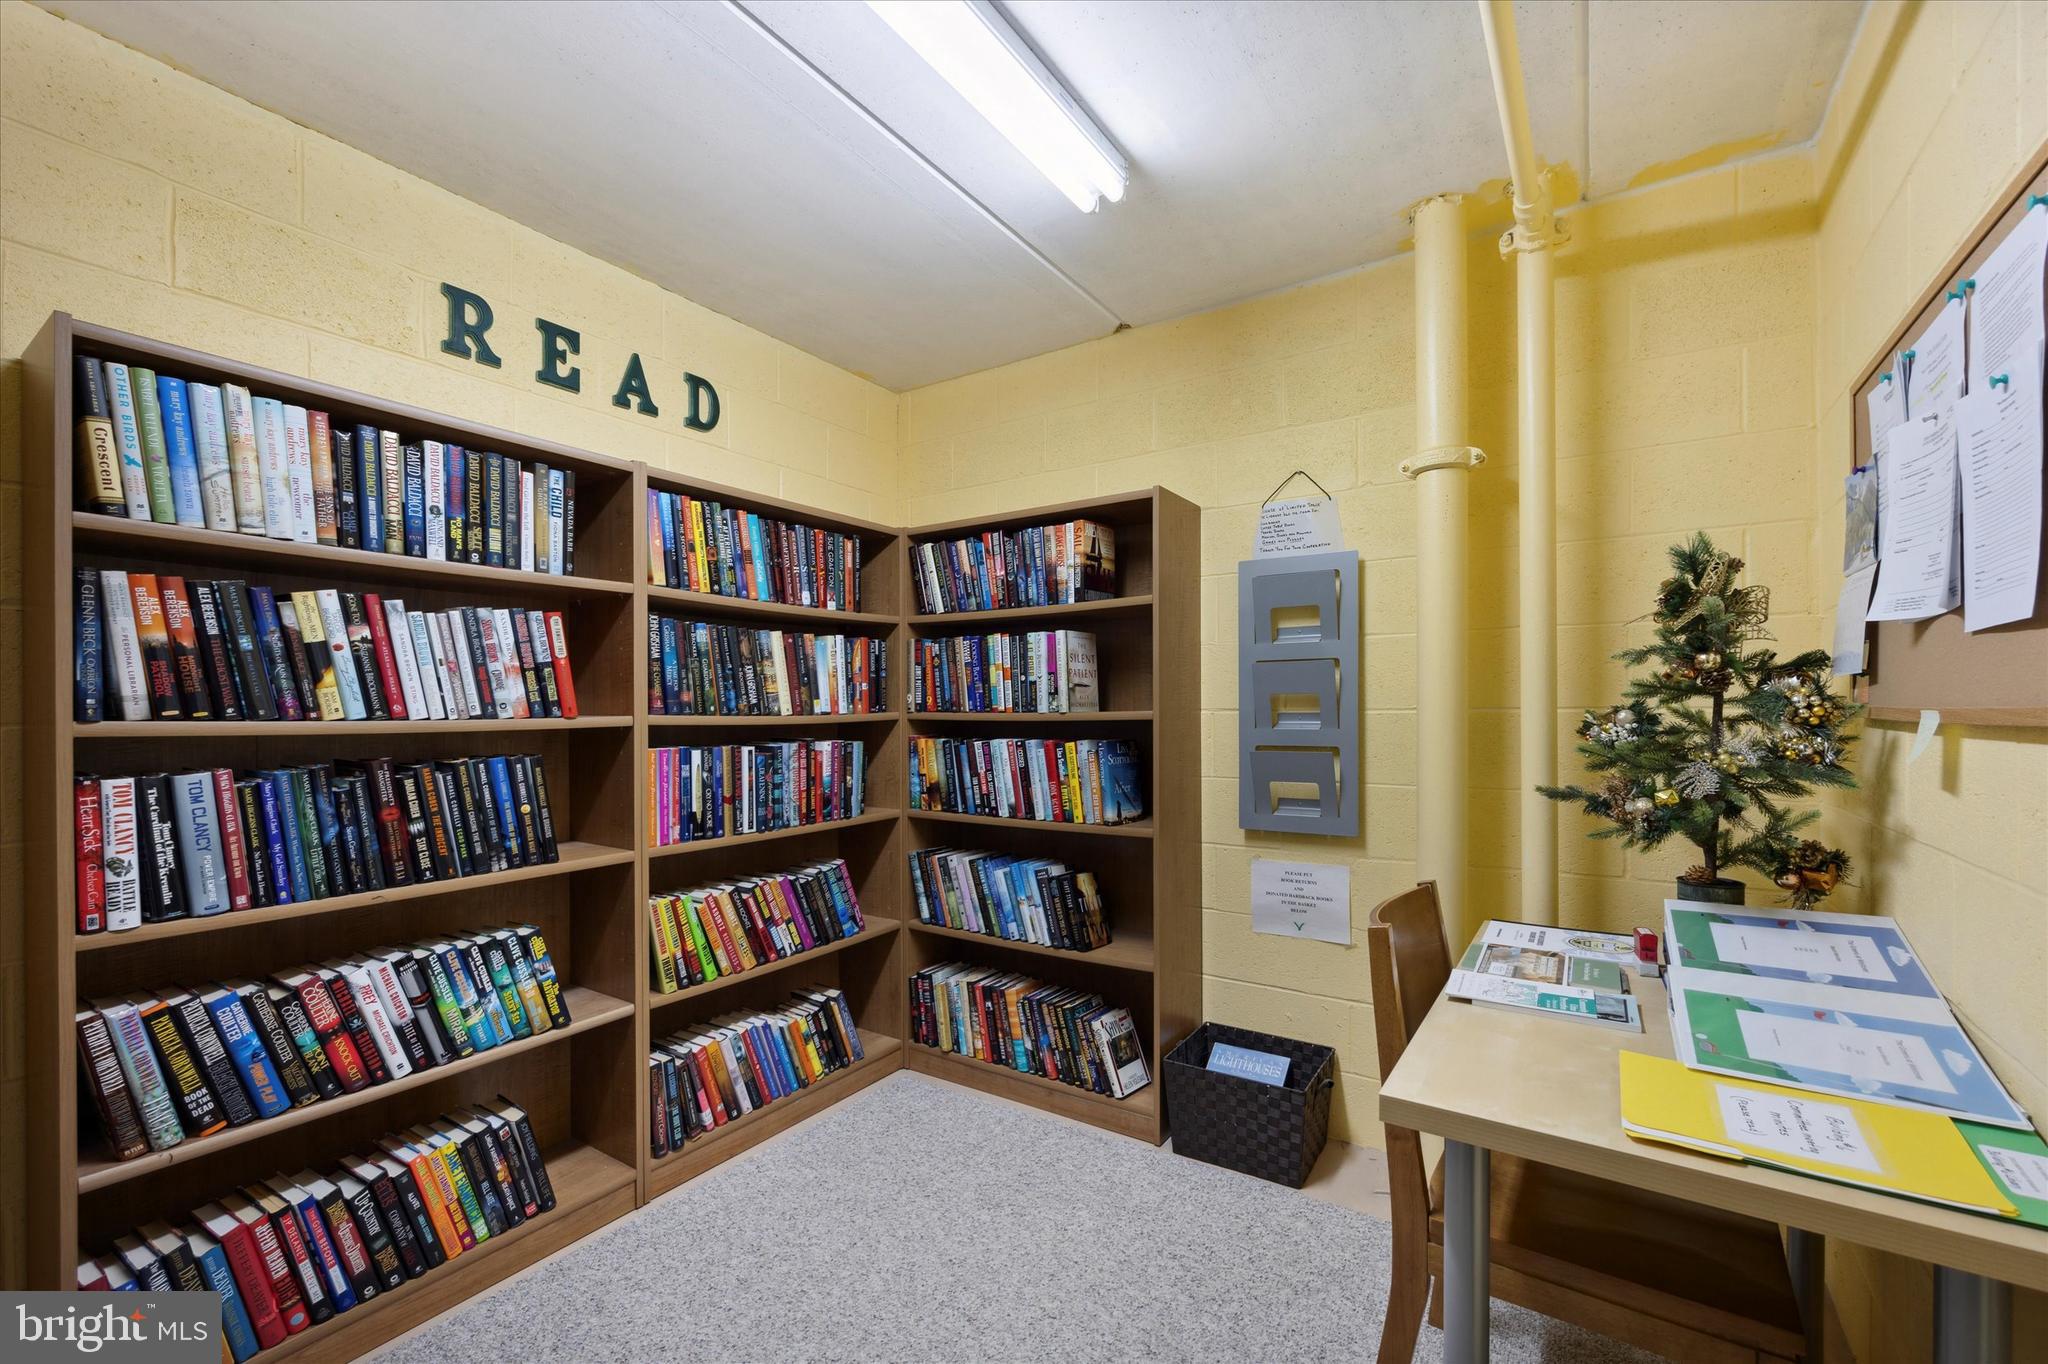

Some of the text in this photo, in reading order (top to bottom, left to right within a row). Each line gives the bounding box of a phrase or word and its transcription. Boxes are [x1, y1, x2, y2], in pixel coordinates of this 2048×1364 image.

[440, 282, 720, 433] READ
[114, 367, 136, 449] OTHER BIRDS
[93, 427, 118, 491] Crescent
[364, 440, 377, 496] DAVID BALDACCI
[384, 436, 401, 515] DAVID BALDACCI
[430, 444, 442, 504] DAVID BALDACCI
[490, 467, 500, 489] DAVID
[407, 451, 422, 517] DAVID BALDACCI
[469, 457, 480, 523] DAVID BALDACCI
[491, 491, 500, 526] BALDACCI
[551, 488, 562, 519] CHILD
[385, 520, 397, 540] MAN
[722, 525, 733, 567] AFTERIMAGE
[1074, 527, 1082, 548] SAIL
[81, 584, 96, 656] GLENN BECK
[134, 587, 152, 625] BERENSON
[149, 597, 161, 615] ALEX
[163, 590, 181, 628] BERENSON
[177, 601, 190, 618] ALEX
[197, 587, 220, 635] ALEX BERENSON
[467, 609, 478, 641] SANDRA
[410, 614, 432, 667] SANDRA BROWN
[480, 619, 494, 641] SANDRA
[648, 614, 661, 659] JOHN GRISHAM
[121, 634, 139, 706] PERSONAL LIBRARIAN
[472, 639, 483, 663] BROWN
[150, 661, 164, 698] PATROL
[178, 656, 194, 694] HOUSE
[744, 665, 758, 704] JOHN GRISHAM
[404, 778, 418, 800] HARLAN
[422, 767, 434, 790] HARLAN
[482, 785, 492, 808] CONNELLY
[112, 783, 134, 855] TOM CLANCY
[188, 780, 211, 852] TOM CLANCY
[262, 783, 279, 835] Mary Higgins Clark
[446, 775, 461, 827] MICHAEL CONNELLY
[147, 787, 173, 905] The Cardinal of the Kremlin
[161, 821, 176, 869] Tom Clancy
[416, 837, 431, 869] STAY CLOSE
[431, 815, 448, 856] THE INNOCENT
[272, 843, 287, 887] My Gal Sunday
[86, 864, 100, 910] Chelsea Cain
[106, 881, 122, 913] READY
[122, 878, 137, 913] BATTLE
[427, 954, 454, 1004] CLIVE CUSSLER
[506, 937, 532, 992] CLIVE CUSSLER
[662, 956, 675, 984] THERAPY
[301, 987, 329, 1030] COULTER
[314, 981, 338, 1024] CATHERINE
[359, 984, 377, 1006] PREY
[378, 966, 408, 1021] MICHAEL CRICHTON
[542, 979, 560, 1016] NAVIGATOR
[118, 1012, 143, 1053] PATRICIA
[180, 998, 227, 1066] PATRICIA CORNWELL
[215, 1007, 241, 1043] COULTER
[230, 1001, 254, 1036] CATHERINE
[252, 992, 293, 1063] CATHERINE COULTER
[281, 1006, 304, 1040] COULTER
[290, 1000, 312, 1032] CATHERINE
[372, 1009, 398, 1056] MICHAEL CRICHTON
[446, 1007, 468, 1045] MIRAGE
[82, 1018, 113, 1056] PATRICIA
[150, 1014, 202, 1094] PATRICIA CORNWELL
[401, 1022, 414, 1039] STATE
[412, 1043, 425, 1059] FEAR
[93, 1053, 126, 1096] CORNWELL
[303, 1050, 320, 1075] BLANK
[312, 1046, 330, 1069] POINT
[334, 1037, 361, 1081] KNOCK OUT
[1214, 1053, 1281, 1078] LIGHTHOUSES
[143, 1092, 177, 1135] TRACE
[183, 1087, 207, 1102] BOOK
[191, 1101, 215, 1117] DEAD
[430, 1156, 444, 1173] JANET
[443, 1151, 479, 1220] JANET EVANOVICH
[358, 1203, 382, 1236] COUNTRY
[282, 1217, 306, 1262] JP DELANEY
[310, 1220, 337, 1267] GIRL BEFORE
[266, 1251, 289, 1280] DEAVER
[300, 1264, 323, 1301] BELIEVE ME
[212, 1269, 234, 1301] DEAVER
